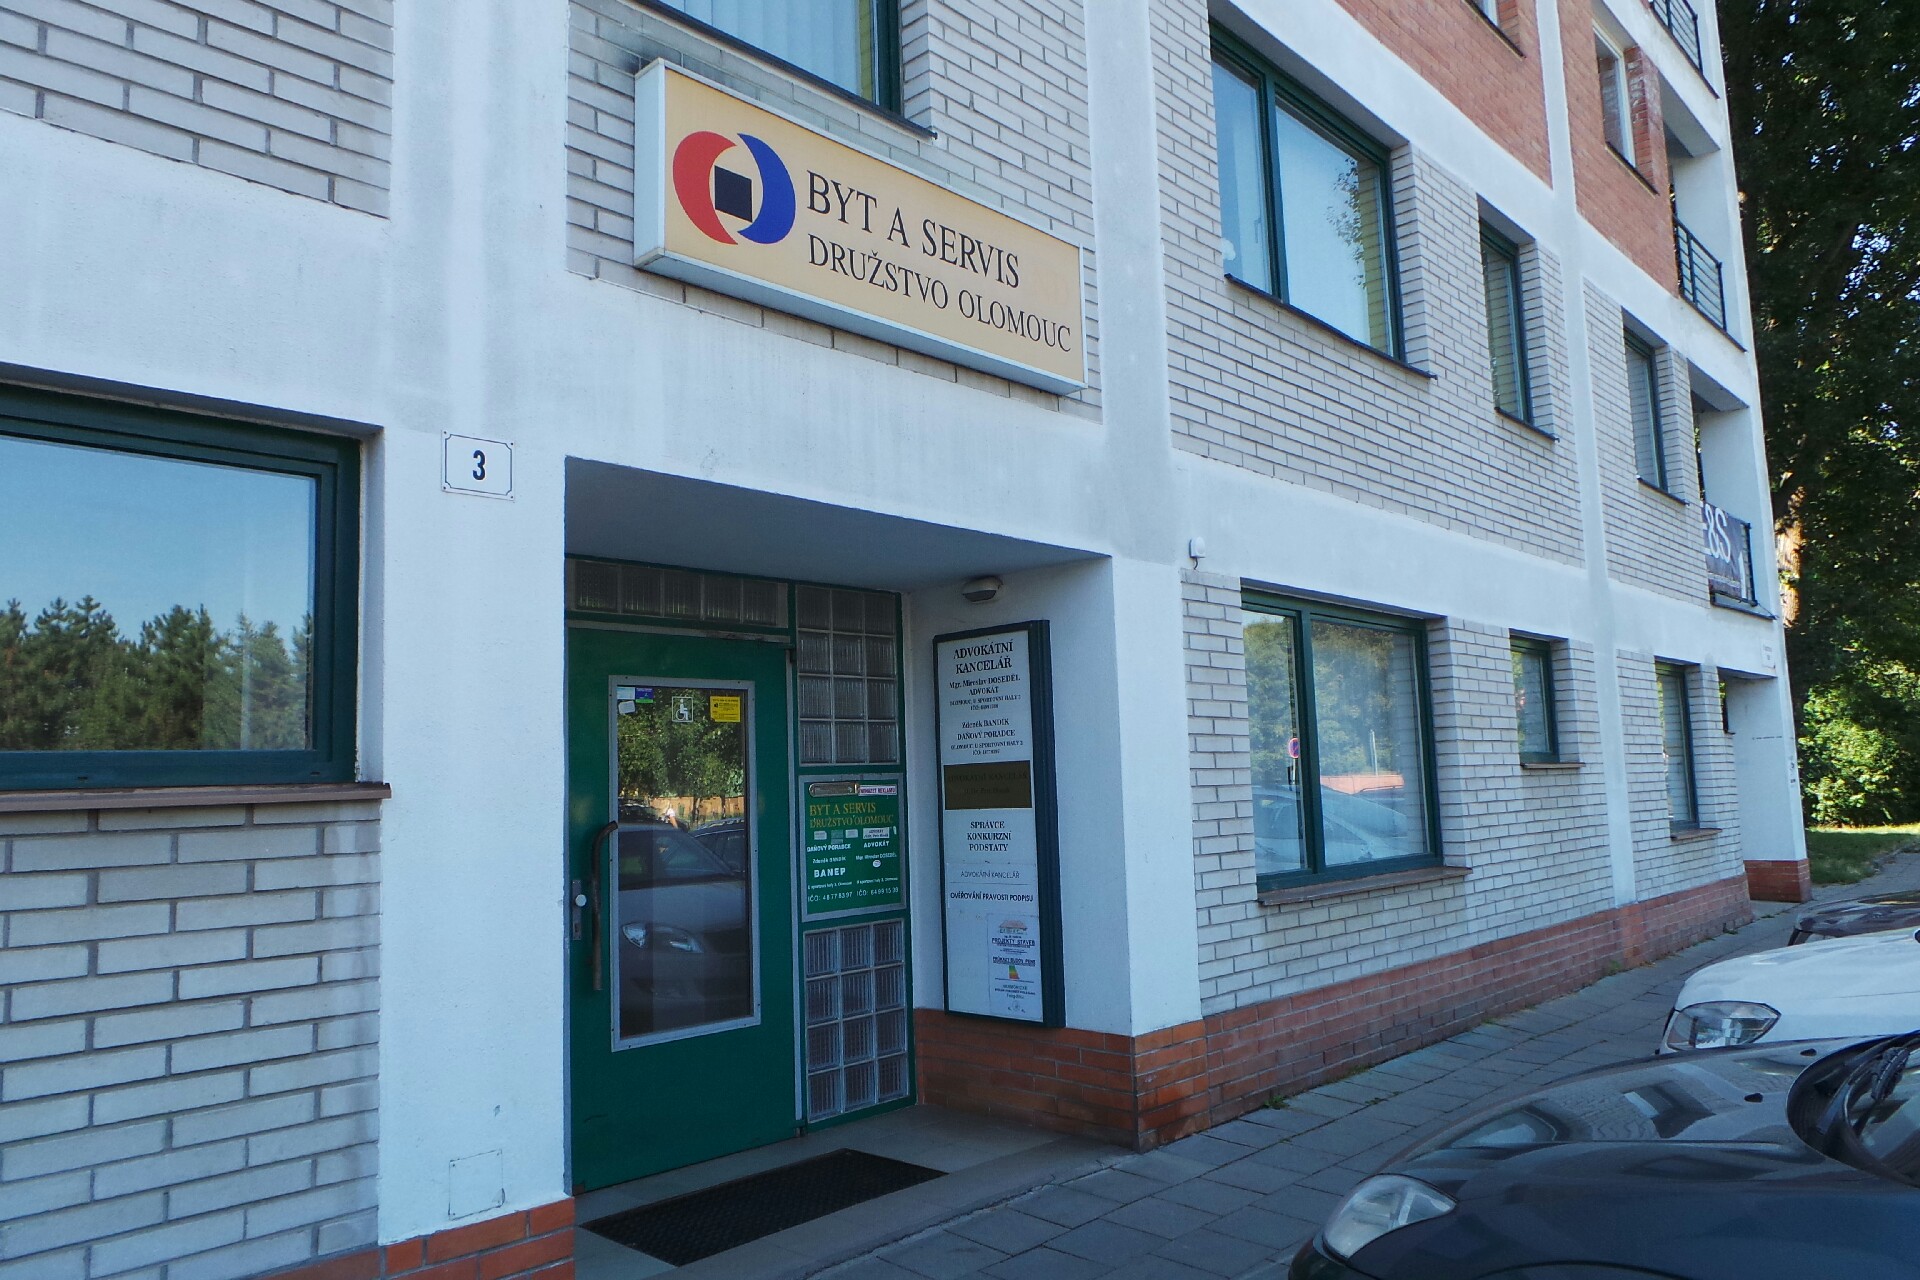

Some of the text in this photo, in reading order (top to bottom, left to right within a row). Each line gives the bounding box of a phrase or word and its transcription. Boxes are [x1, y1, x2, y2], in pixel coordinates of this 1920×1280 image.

[806, 170, 1020, 289] BYT A SERVIS
[808, 233, 1073, 353] DRUŽSTVO OLOMOUC
[472, 449, 486, 481] 3
[954, 639, 1013, 659] ADVOKÁTNÍ
[956, 656, 1012, 674] KANCELÁŘ
[958, 729, 1015, 739] DAŇOVÝ PORADCE
[811, 803, 876, 816] BYT A SERVIS
[811, 815, 893, 828] DRUŽSTVO OLOMOUC
[970, 820, 1005, 829] SPRÁVCE
[967, 831, 1011, 840] KONKURZNÍ
[814, 868, 845, 877] BANEP
[950, 891, 981, 899] OVĚŘOVÁNÍ
